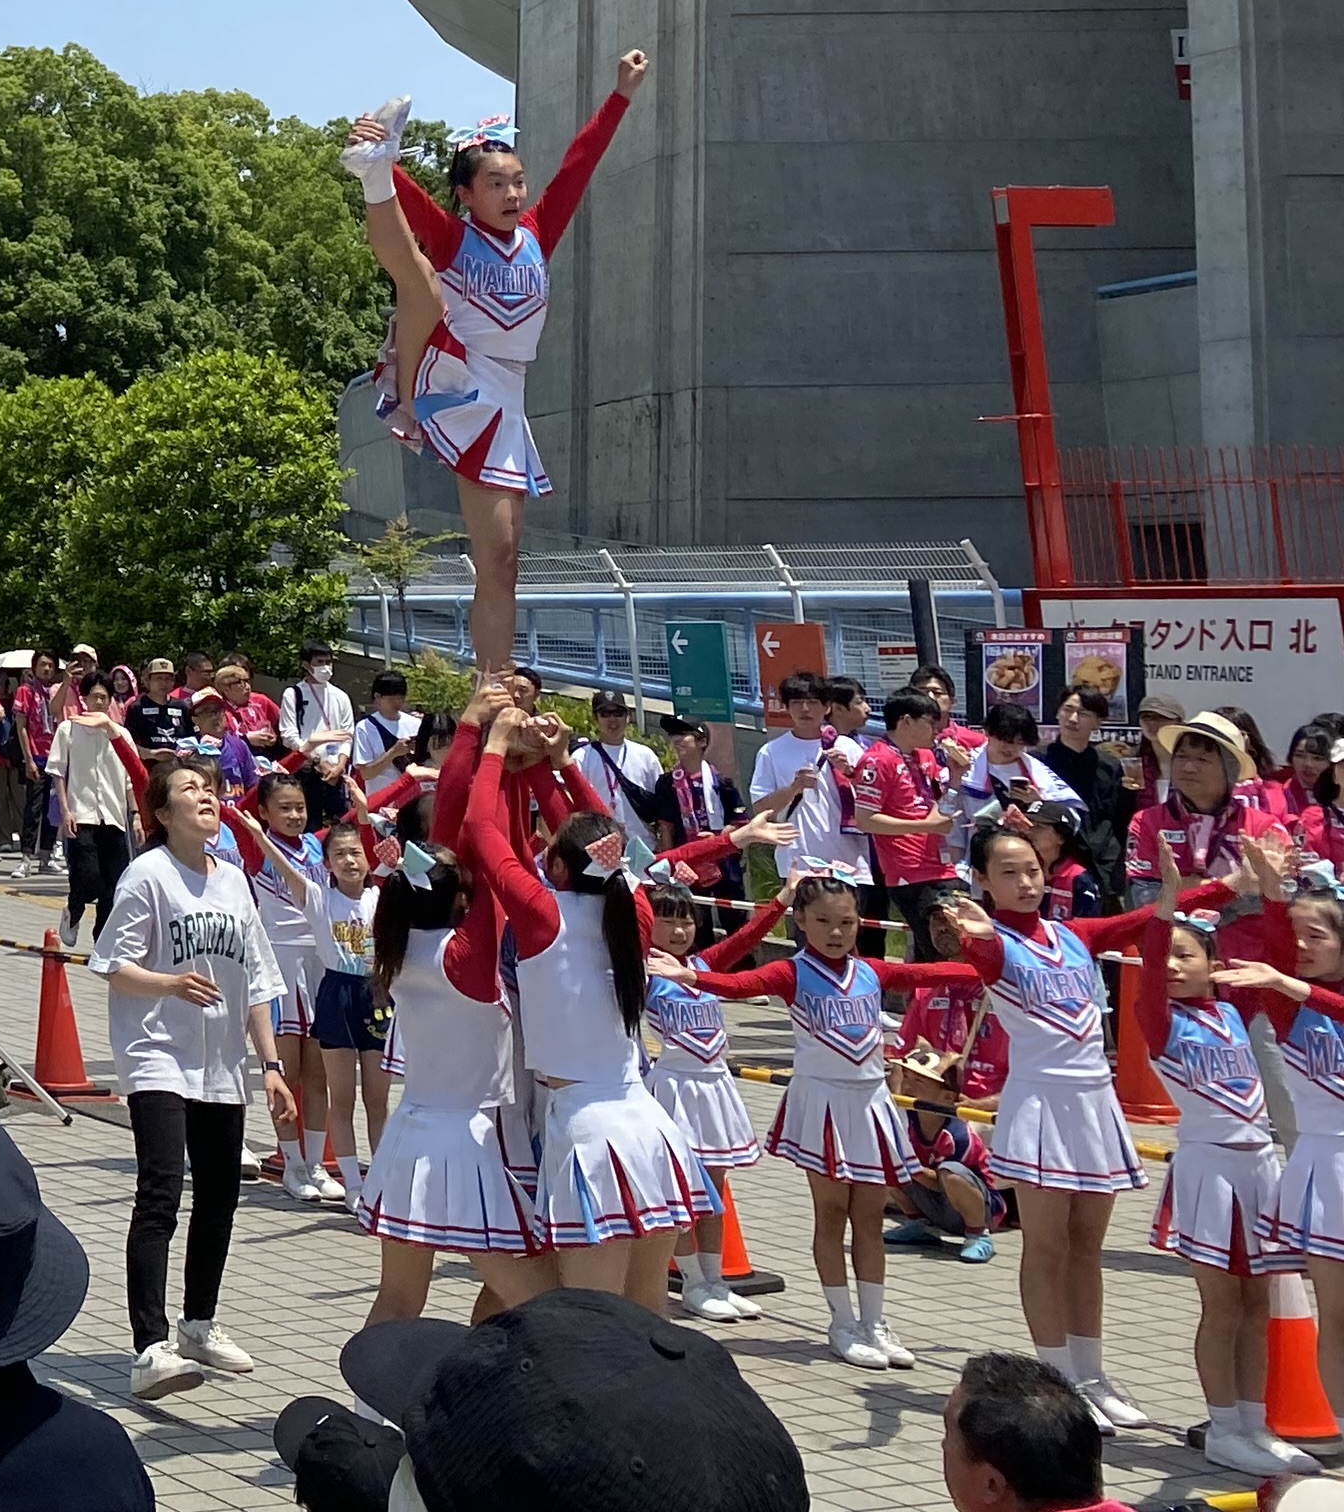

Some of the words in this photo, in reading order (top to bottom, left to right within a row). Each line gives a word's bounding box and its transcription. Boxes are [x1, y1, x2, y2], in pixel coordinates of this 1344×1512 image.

[1289, 618, 1318, 654] 北
[1186, 665, 1254, 683] ENTRANCE
[803, 990, 881, 1037] MARIN
[1304, 1024, 1344, 1080] MA
